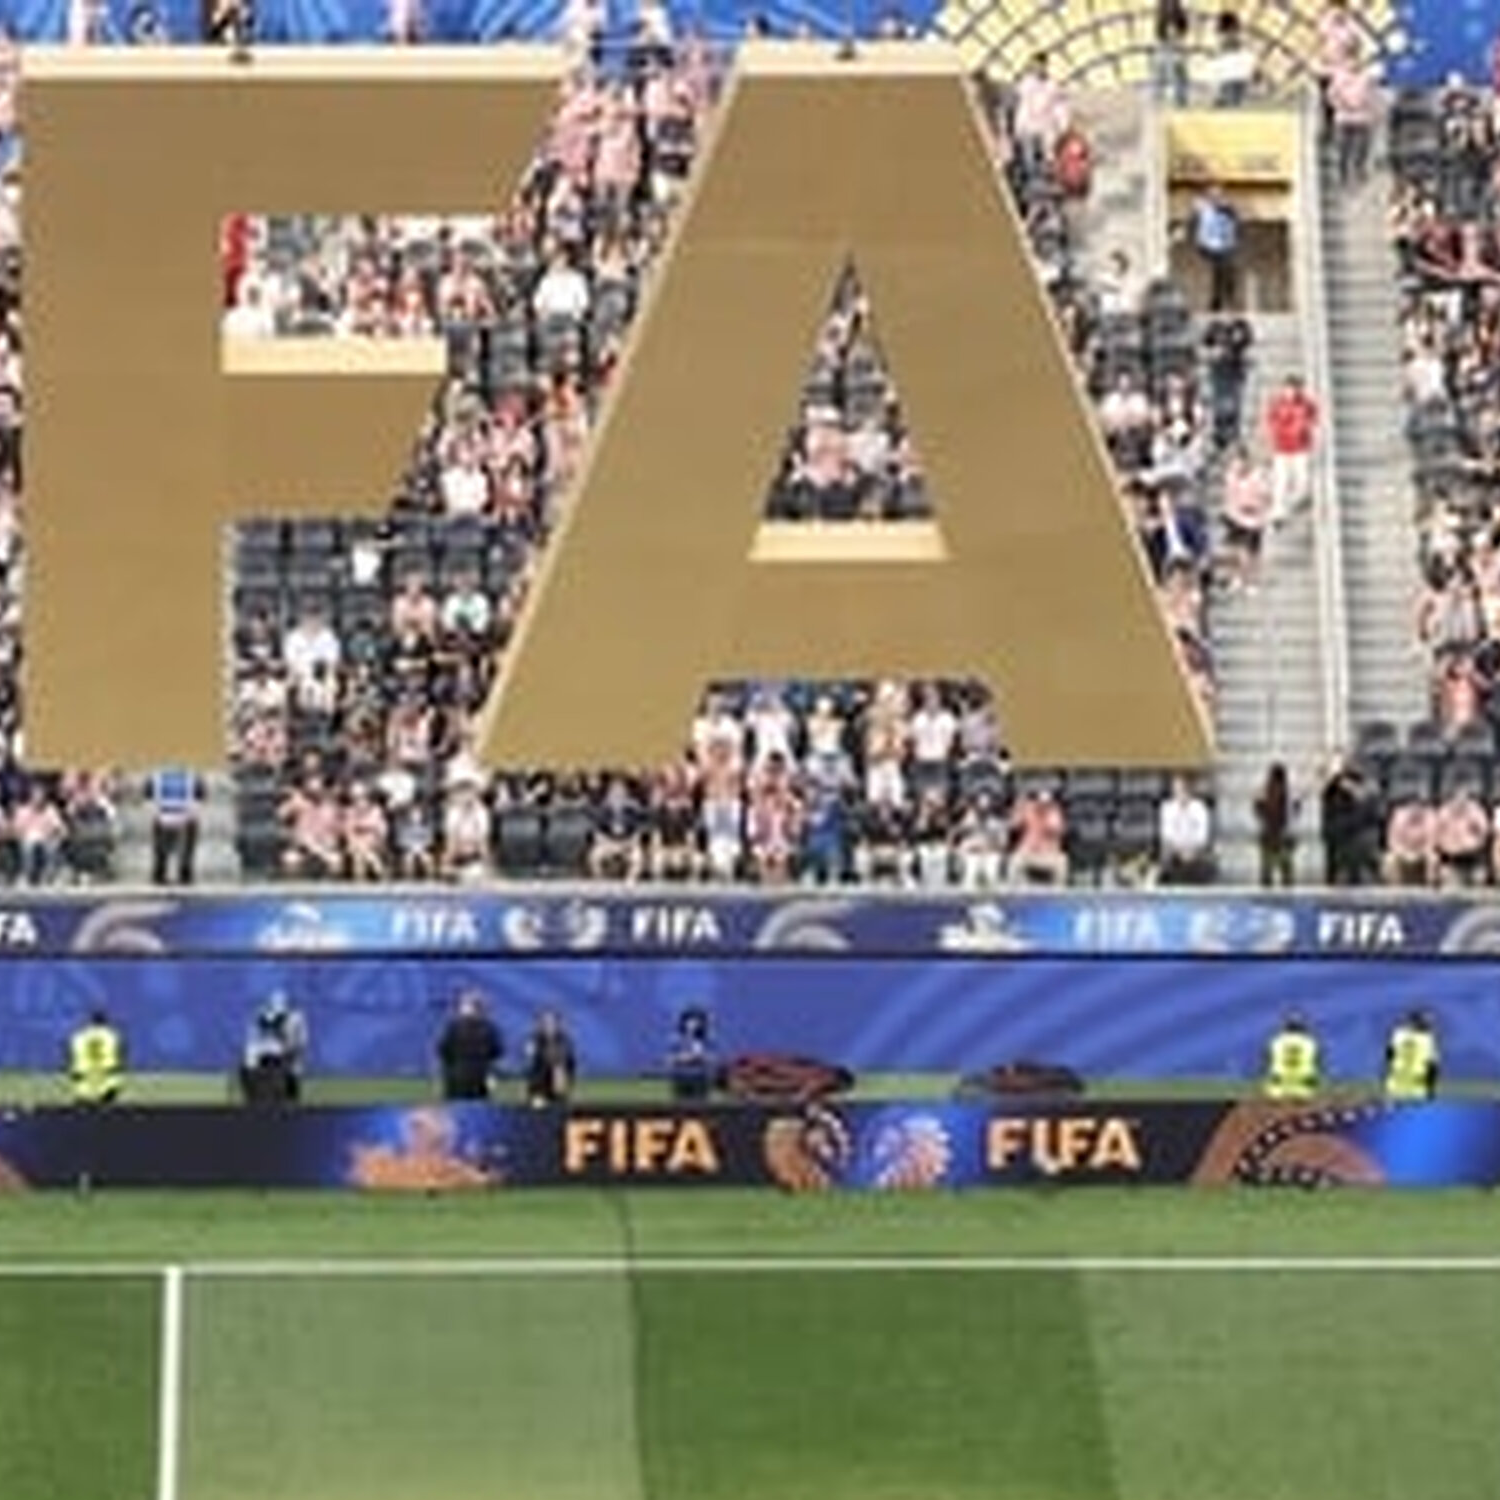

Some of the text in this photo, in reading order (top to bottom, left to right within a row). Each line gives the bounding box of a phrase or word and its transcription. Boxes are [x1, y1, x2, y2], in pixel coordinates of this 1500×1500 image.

[389, 908, 475, 938] FIFA
[633, 910, 718, 938] FIFA
[1075, 910, 1161, 939] FIFA
[1318, 914, 1404, 942] FIFA
[566, 1120, 715, 1169] FIFA
[989, 1118, 1140, 1168] FIFA
